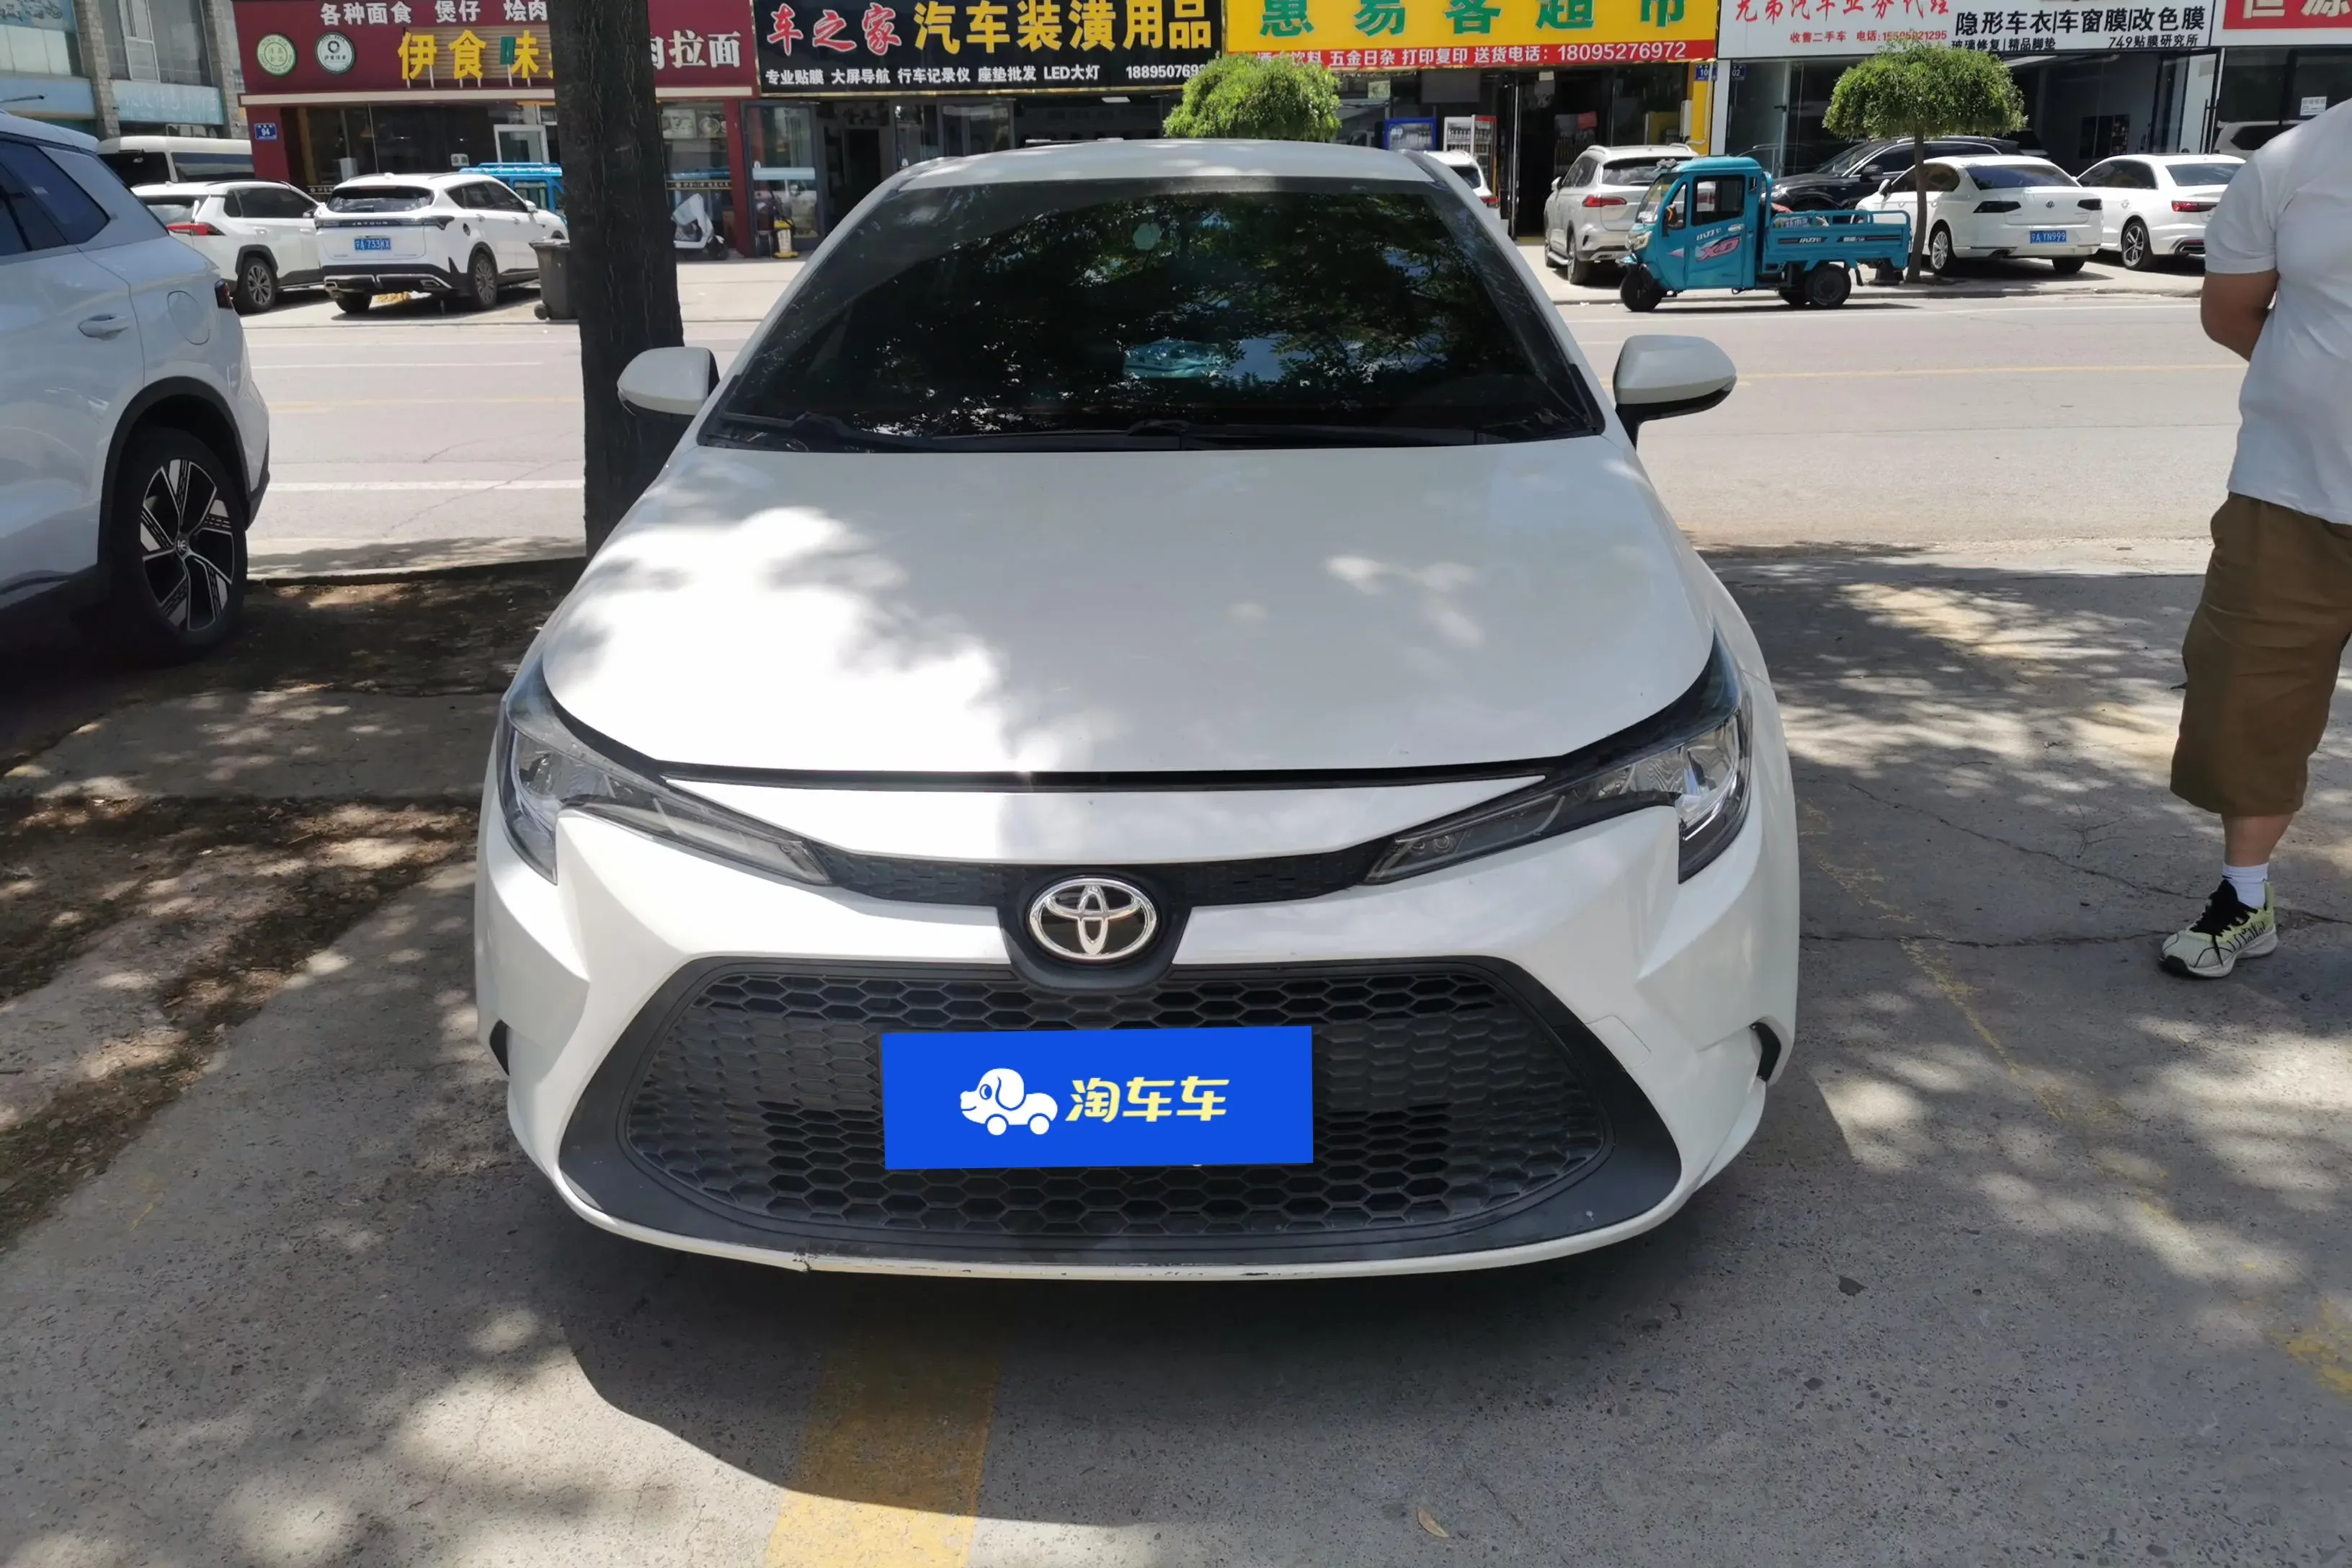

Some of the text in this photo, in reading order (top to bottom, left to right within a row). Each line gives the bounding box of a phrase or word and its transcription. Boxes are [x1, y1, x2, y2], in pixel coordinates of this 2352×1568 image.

[320, 1, 412, 26] 各种面食
[435, 0, 481, 23] 煲仔
[767, 0, 1211, 55] 车之家 汽车装潢用品
[398, 29, 553, 79] 伊食味
[1329, 48, 1396, 67] 五金日杂
[1402, 47, 1468, 66] 打印复印
[1556, 41, 1687, 61] 18095276972
[765, 68, 824, 86] 专业贴膜
[831, 68, 891, 85] 大屏导航
[897, 66, 971, 84] 行车记录仪
[978, 66, 1037, 83] 座垫批发
[1043, 65, 1100, 81] LED大灯
